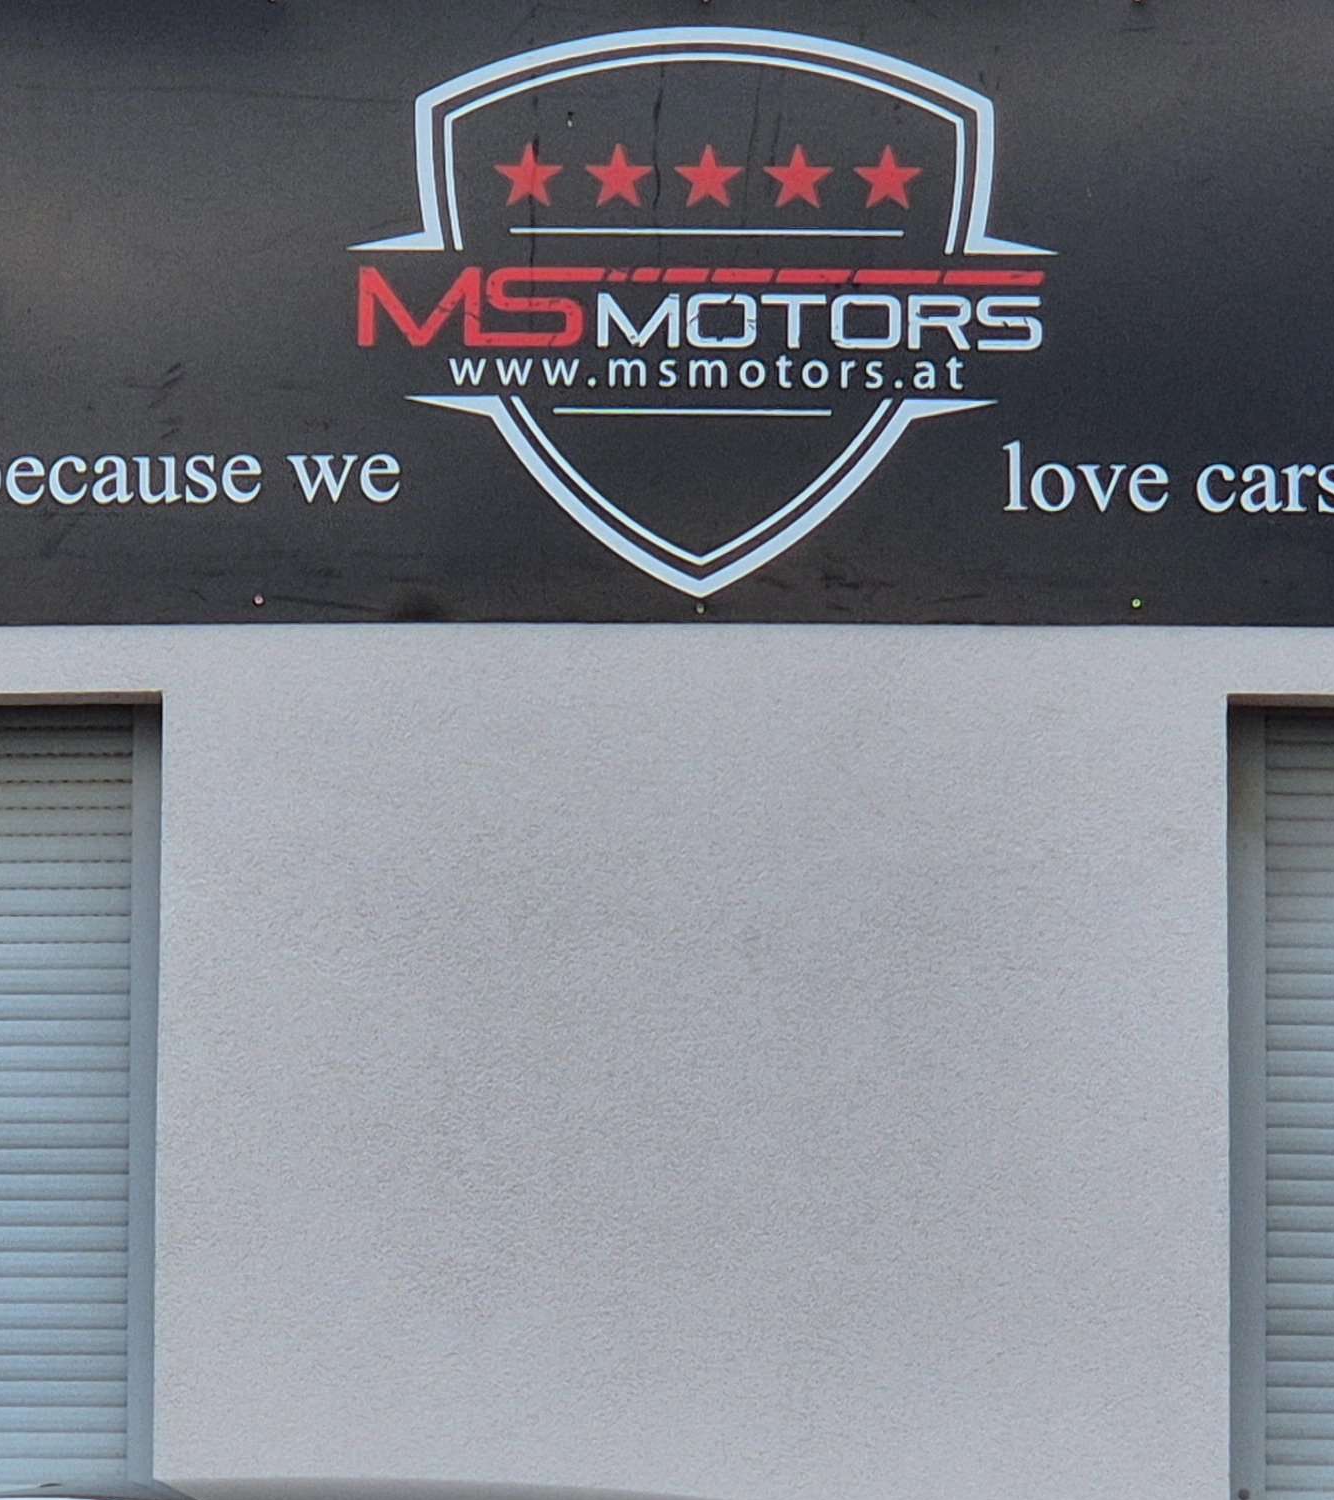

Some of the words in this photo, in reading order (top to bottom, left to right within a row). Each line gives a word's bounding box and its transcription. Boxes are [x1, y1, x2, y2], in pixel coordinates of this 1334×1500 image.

[450, 355, 965, 390] www.msmotors.at
[288, 452, 401, 504] we
[1003, 440, 1170, 512] love
